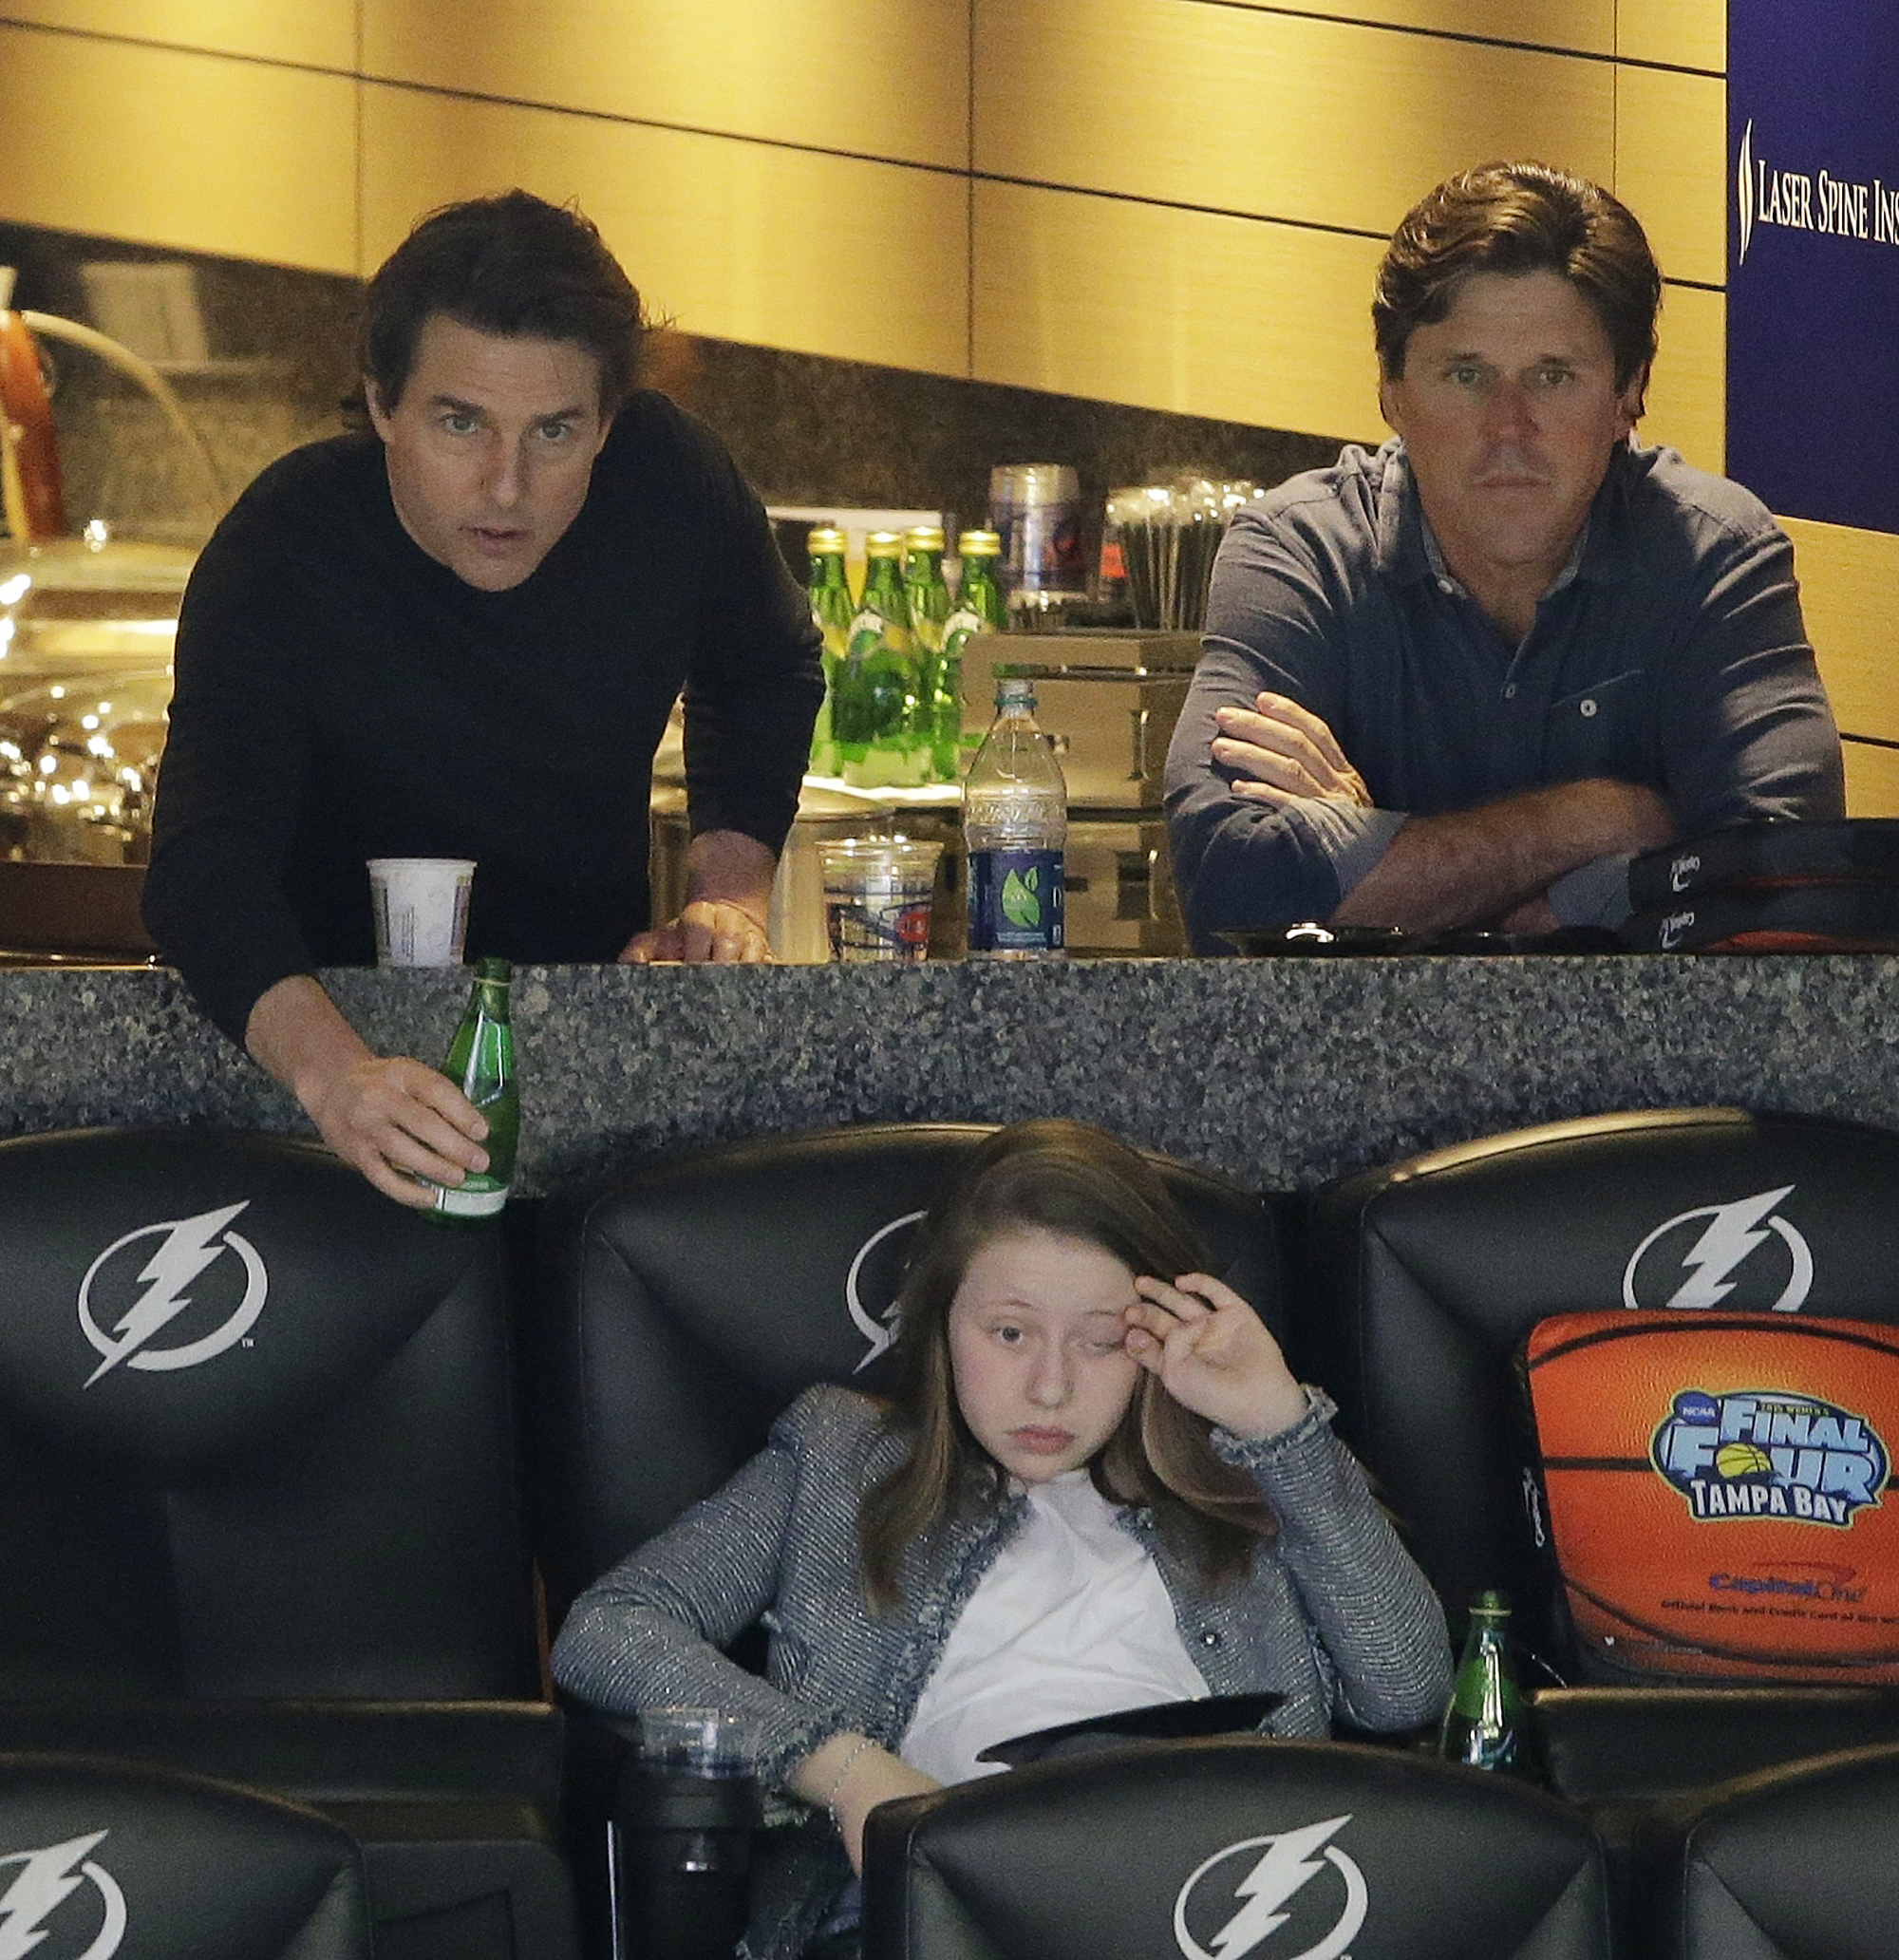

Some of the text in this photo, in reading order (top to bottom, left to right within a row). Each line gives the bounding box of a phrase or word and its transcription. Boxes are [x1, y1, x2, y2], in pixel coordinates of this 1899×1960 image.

[1758, 160, 1814, 230] LASER
[1817, 169, 1869, 239] SPINE
[1683, 1405, 1716, 1418] NCAA
[1720, 1399, 1870, 1453] FINAL
[1690, 1479, 1848, 1523] TAMPA BAY
